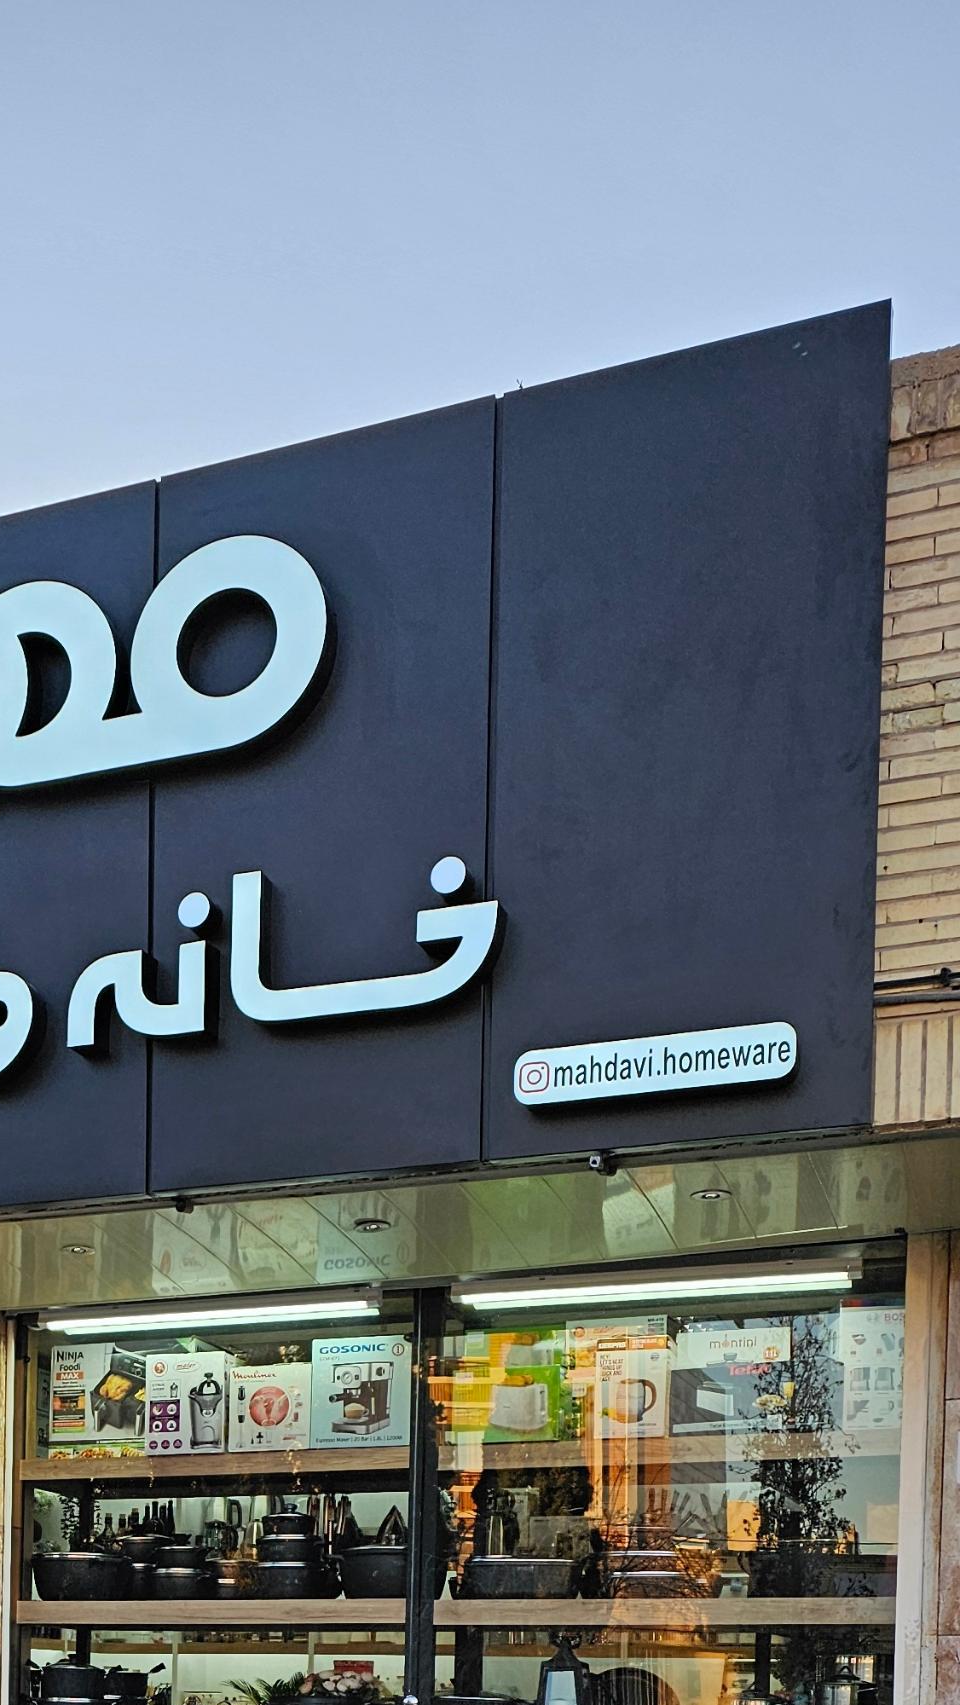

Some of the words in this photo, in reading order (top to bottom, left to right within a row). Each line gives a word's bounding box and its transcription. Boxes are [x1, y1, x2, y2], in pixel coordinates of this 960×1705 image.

[67, 856, 499, 1048] خانه
[553, 1040, 791, 1087] mahdavi.homeware
[320, 1343, 386, 1354] GOSONIC
[709, 1335, 757, 1350] montini
[56, 1351, 84, 1362] NINJA
[60, 1363, 80, 1371] Foodi
